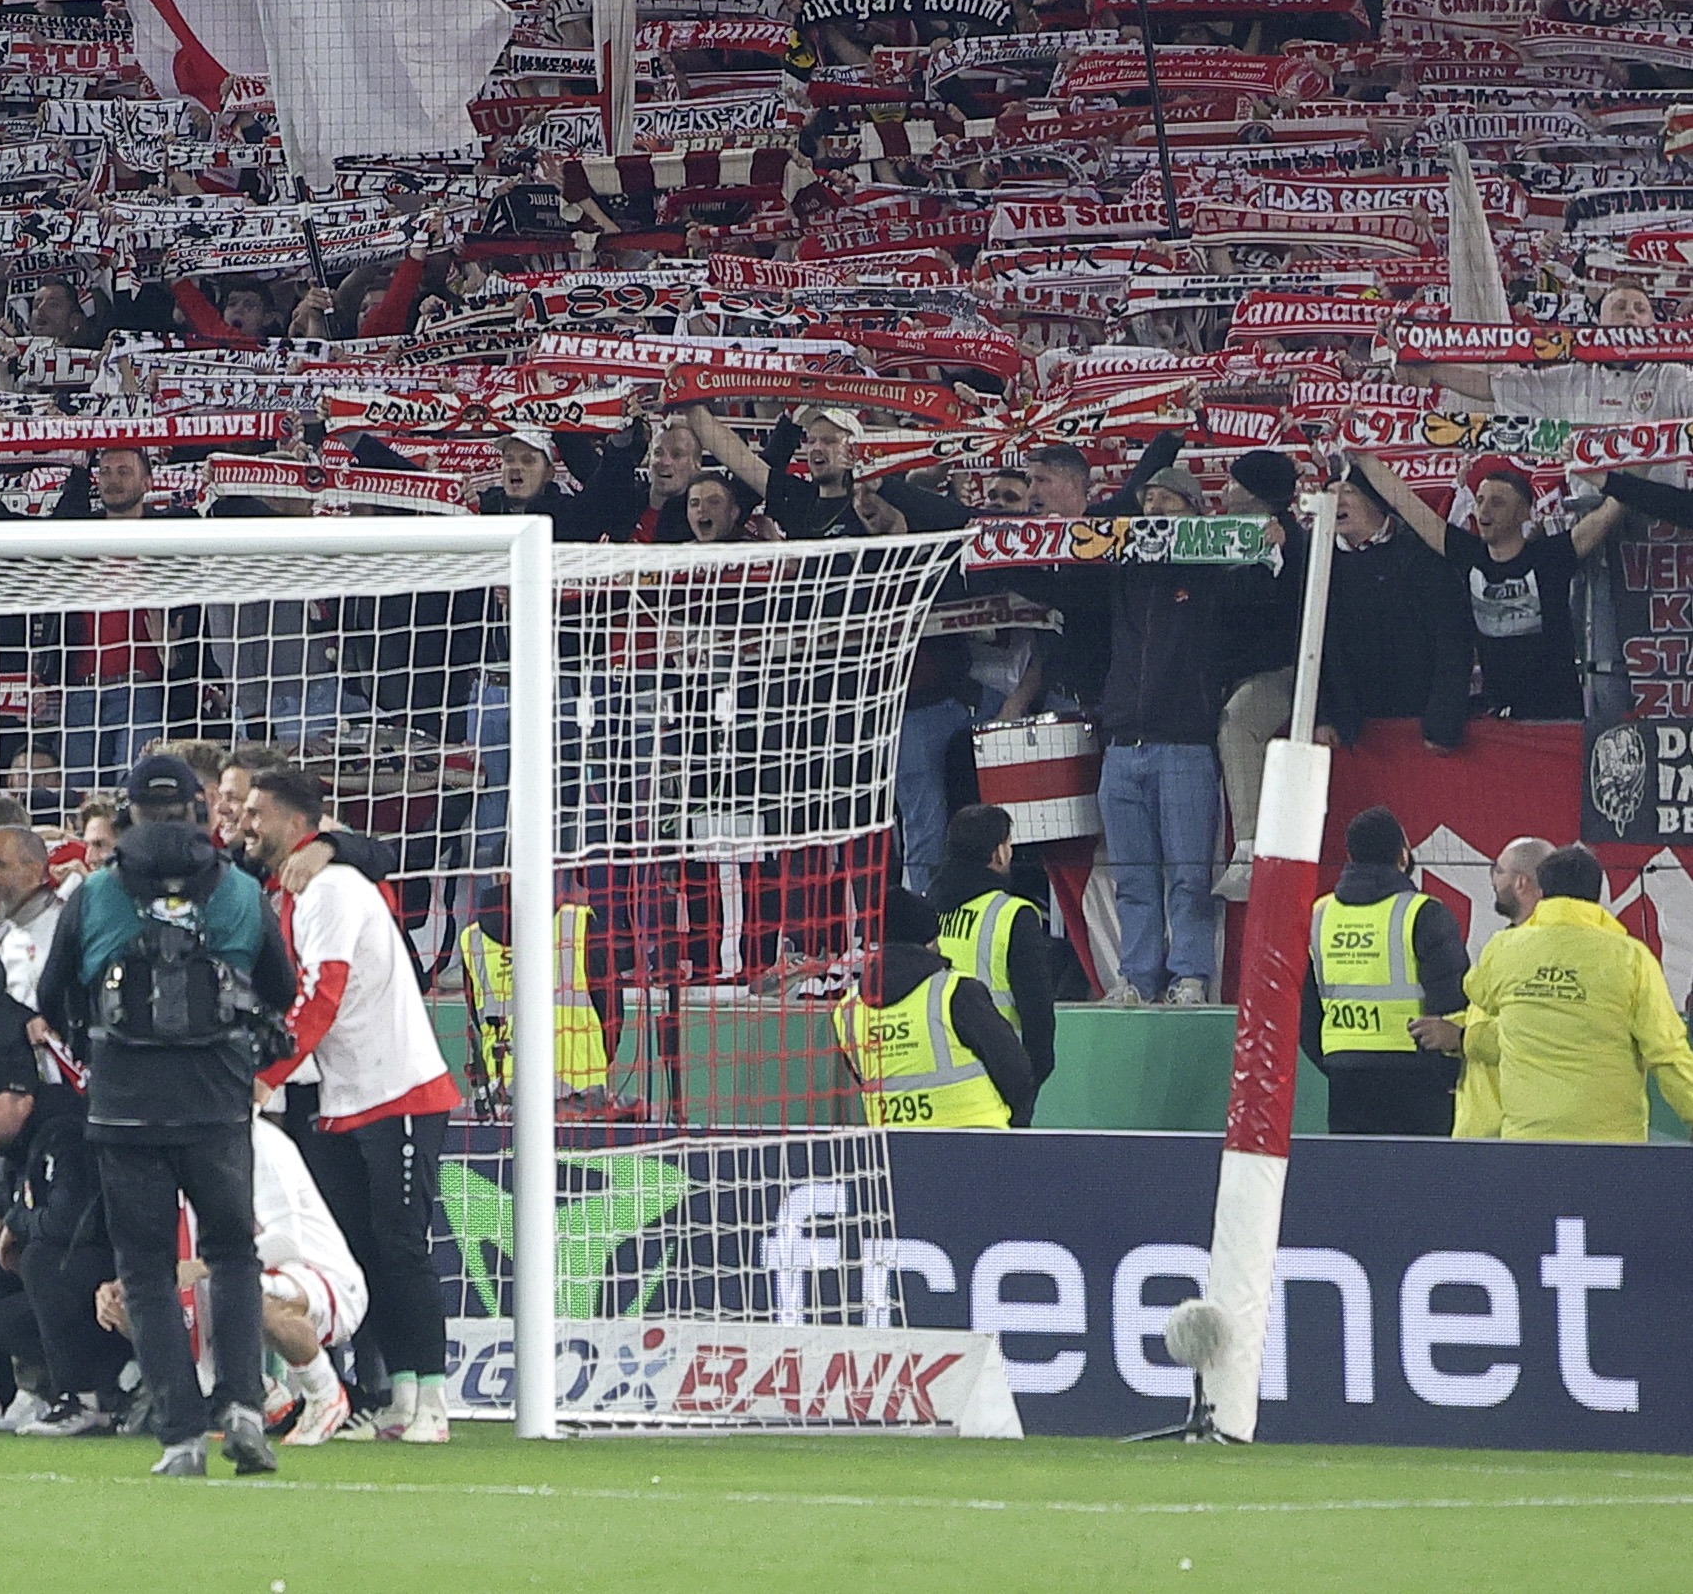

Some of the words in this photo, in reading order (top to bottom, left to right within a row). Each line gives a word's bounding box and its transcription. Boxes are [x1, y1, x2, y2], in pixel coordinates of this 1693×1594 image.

[230, 78, 266, 101] VfB
[1011, 207, 1069, 229] VfB
[1395, 329, 1530, 351] COMMANDO
[696, 370, 794, 391] Commando
[826, 379, 906, 402] Cannstatt
[912, 388, 938, 407] 97
[174, 412, 258, 439] KURVE
[1055, 415, 1104, 435] 97
[1574, 424, 1678, 463] CC97
[335, 472, 440, 500] Cannstatt
[1330, 931, 1377, 950] SDS
[1536, 966, 1578, 984] SDS
[1330, 1003, 1382, 1033] 2031
[868, 1022, 911, 1042] SDS
[879, 1093, 934, 1124] 2295
[760, 1183, 1641, 1413] freenet
[672, 1344, 963, 1422] BANK
